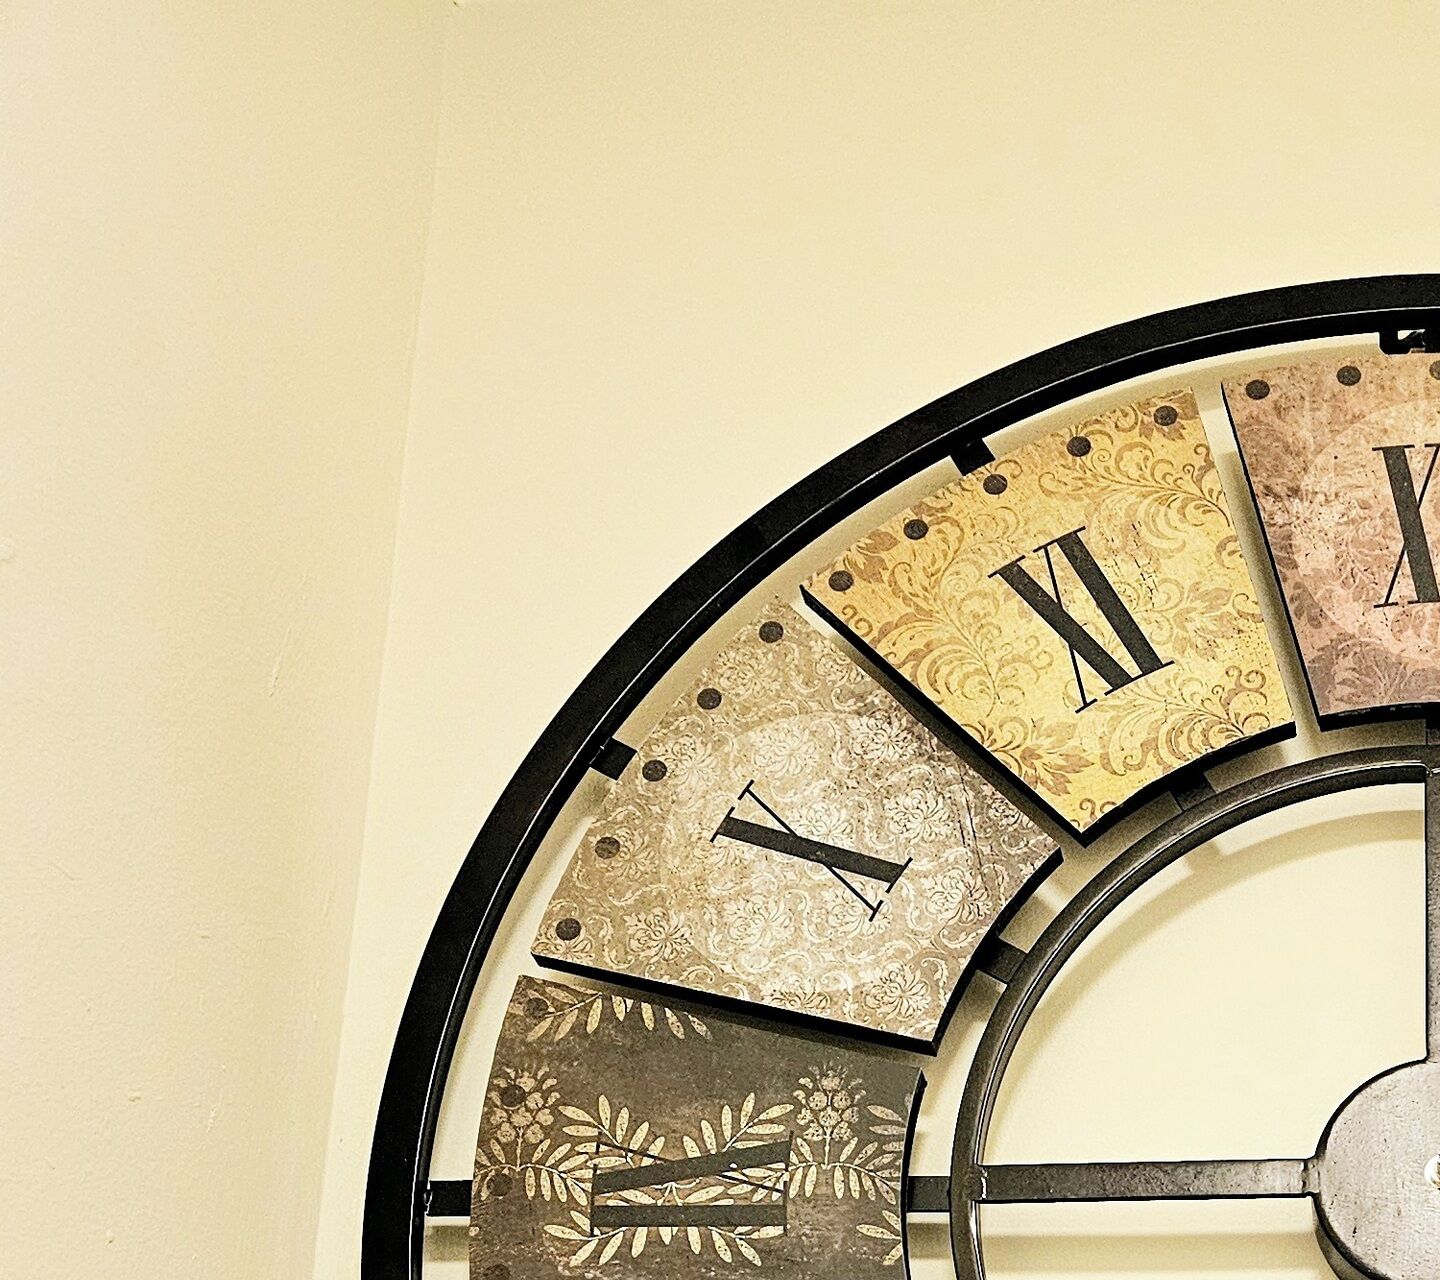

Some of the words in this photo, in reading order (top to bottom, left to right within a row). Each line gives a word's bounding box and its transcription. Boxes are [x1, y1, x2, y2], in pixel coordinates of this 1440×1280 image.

[988, 525, 1174, 714] XI
[710, 779, 912, 922] X
[590, 1131, 794, 1237] IX
